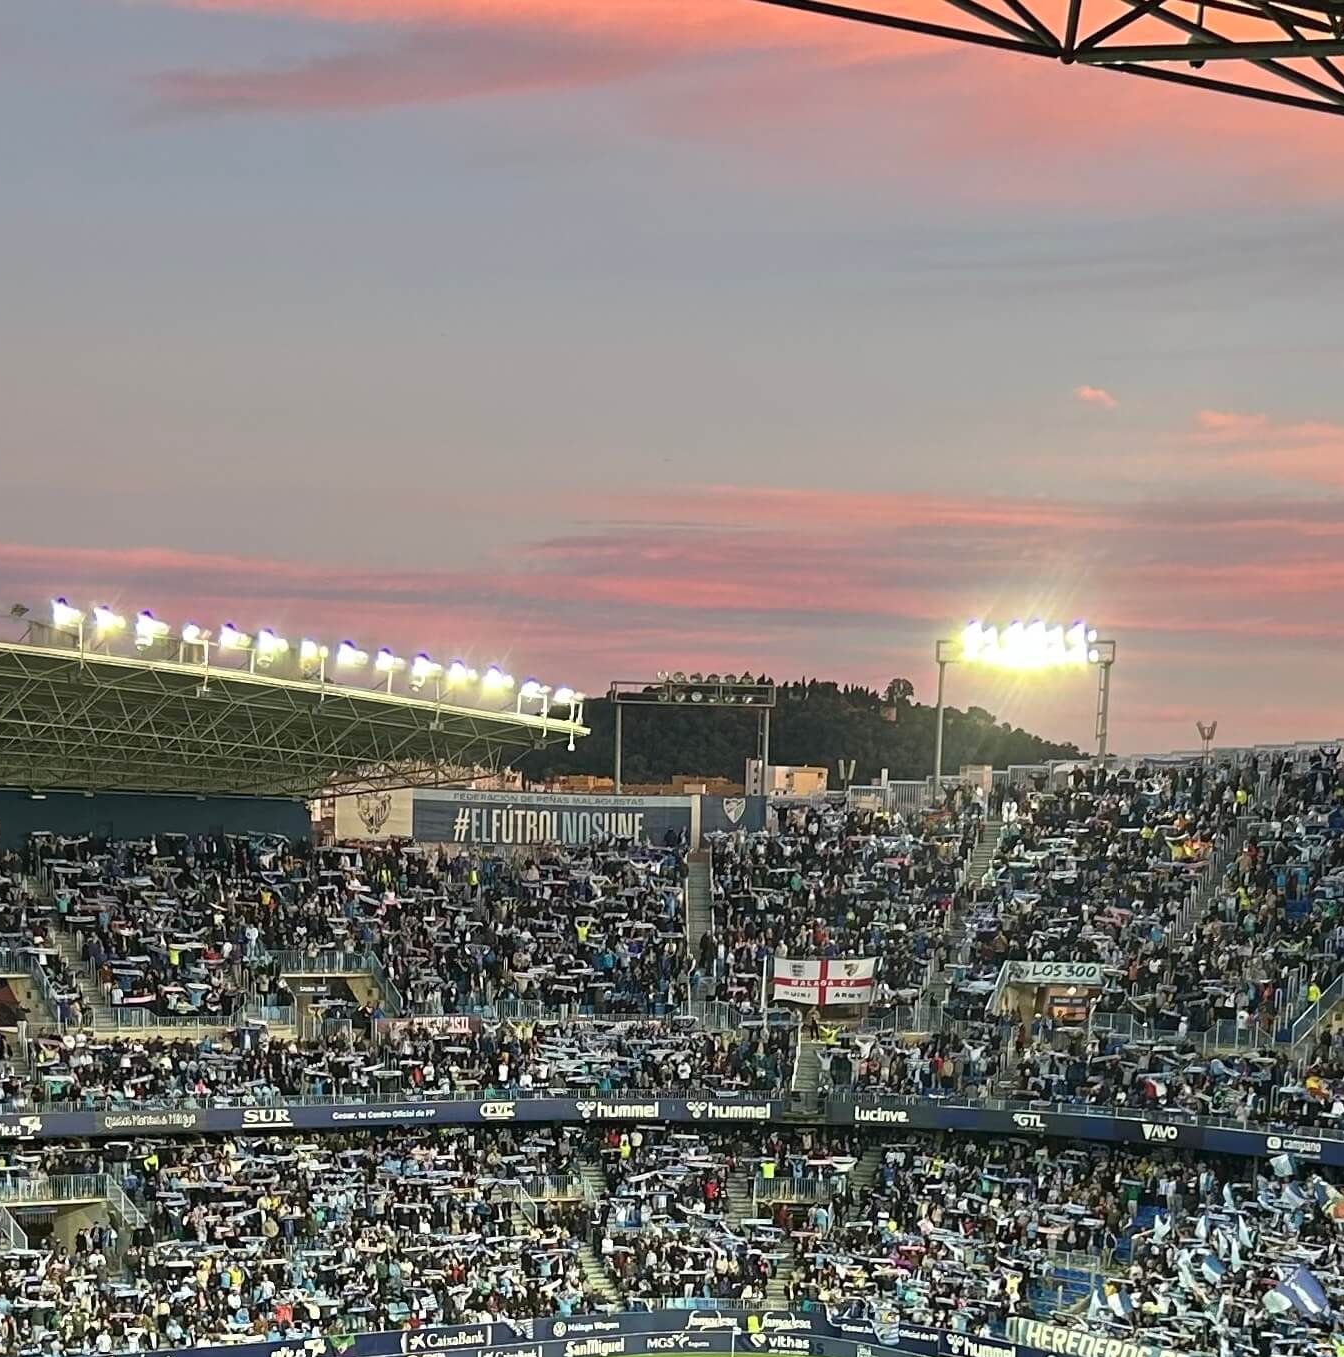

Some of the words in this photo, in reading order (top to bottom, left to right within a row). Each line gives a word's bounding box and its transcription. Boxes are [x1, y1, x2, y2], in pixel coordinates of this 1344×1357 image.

[1032, 964, 1063, 977] LOS
[1065, 964, 1098, 978] 300
[243, 1109, 291, 1123] SUR
[597, 1101, 659, 1118] hummel
[707, 1102, 771, 1119] hummel
[427, 1331, 485, 1348] CaixaBank
[647, 1337, 674, 1349] MGS
[769, 1335, 810, 1350] vithas
